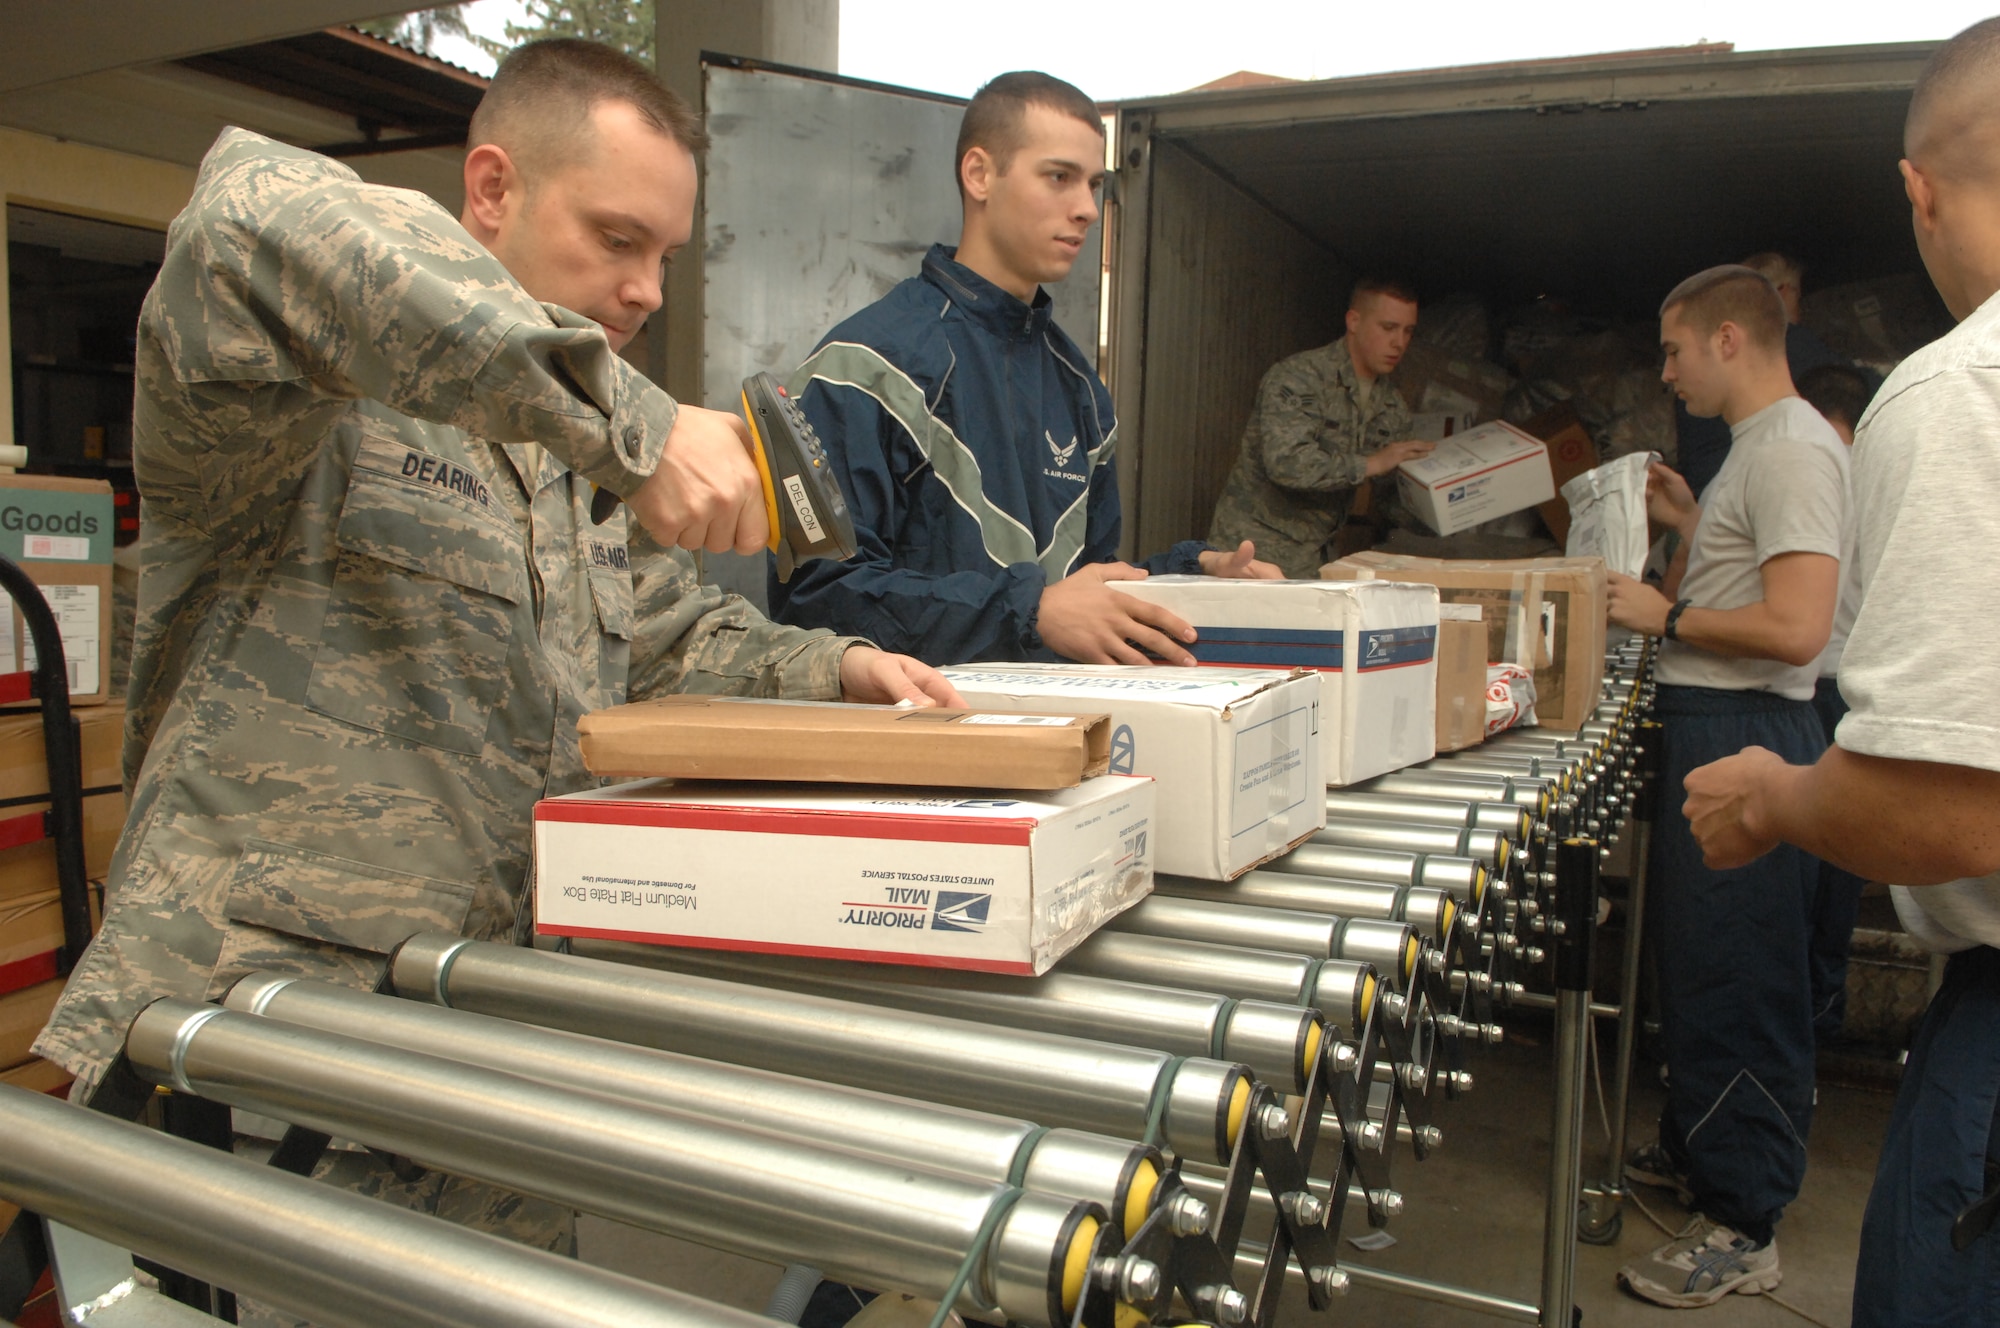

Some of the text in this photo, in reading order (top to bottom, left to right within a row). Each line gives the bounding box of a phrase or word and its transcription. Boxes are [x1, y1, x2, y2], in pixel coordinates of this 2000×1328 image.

[401, 452, 489, 507] DEARING
[1050, 470, 1062, 478] AIR
[1062, 472, 1086, 483] FORCE
[790, 483, 817, 530] DEL CON
[1, 505, 98, 535] Goods
[607, 546, 629, 568] AIR
[1042, 676, 1180, 686] SHIPPING
[581, 875, 697, 891] For Domestic and International Use
[861, 870, 995, 886] UNITED STATES POSTAL SERVICE
[563, 886, 698, 910] Medium Flat Rate Box
[885, 887, 931, 905] MAIL
